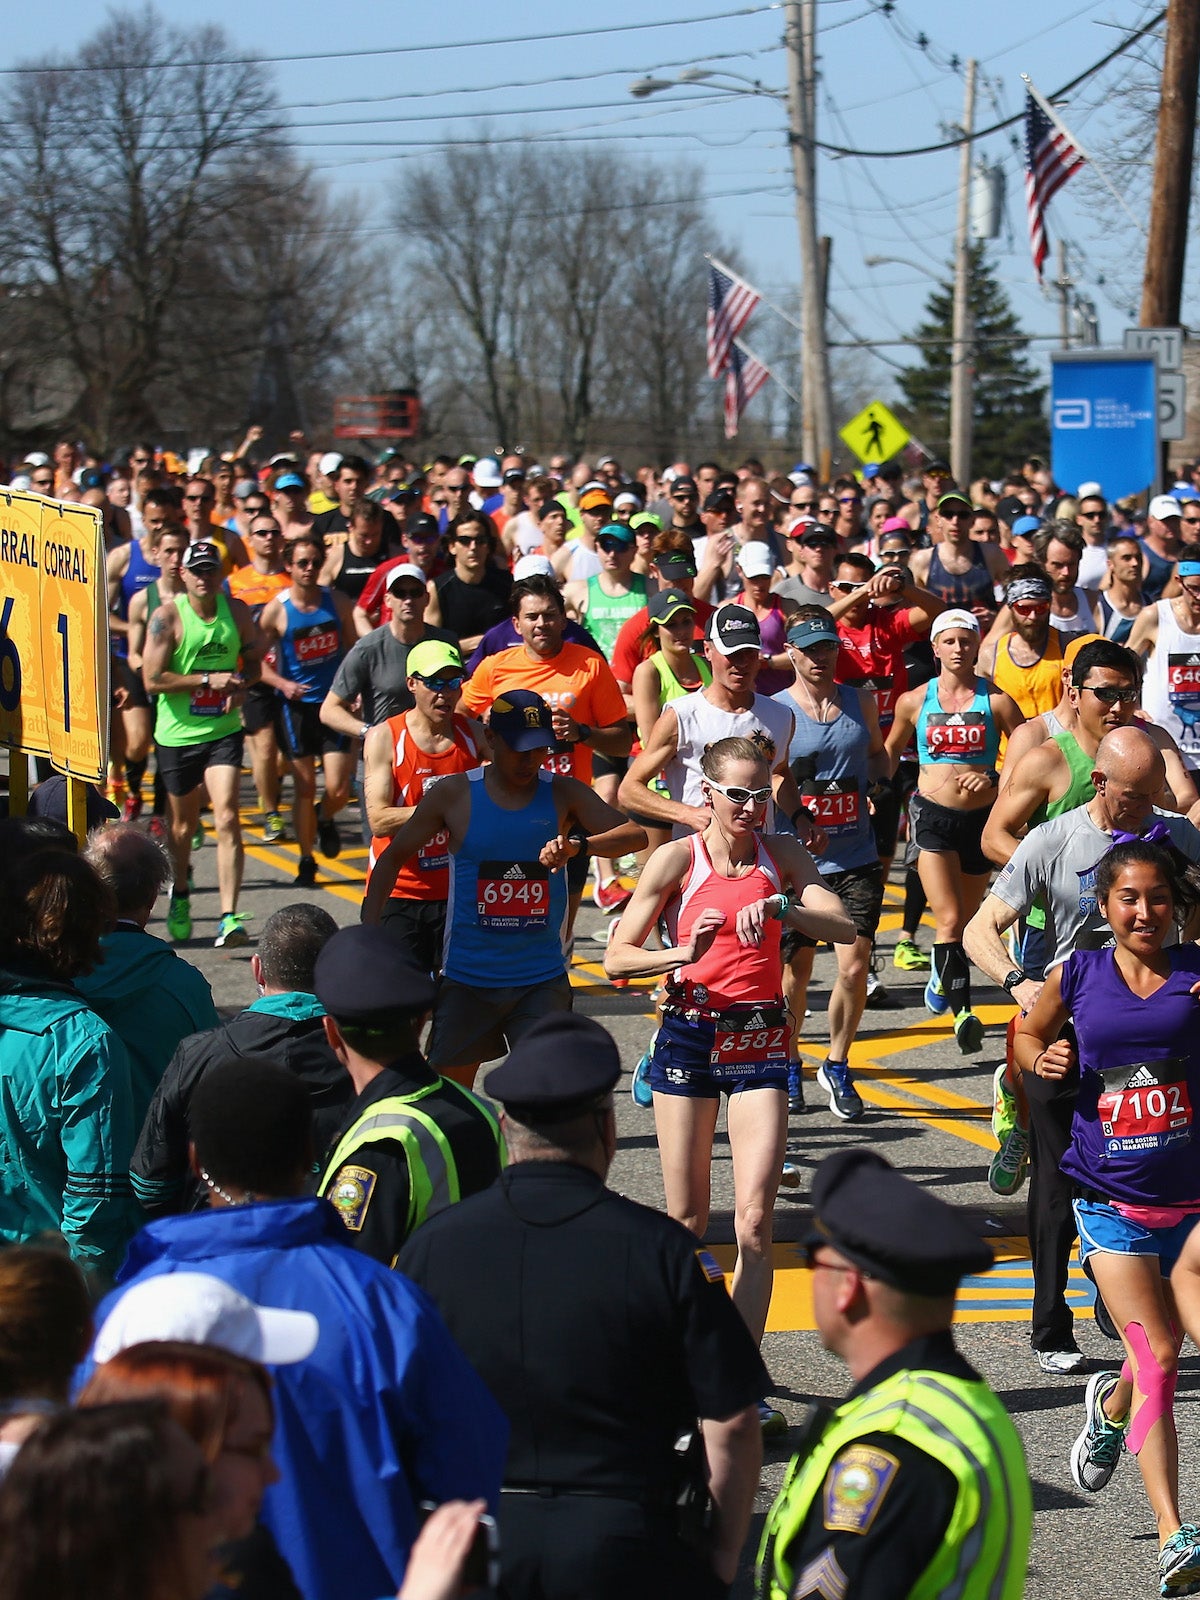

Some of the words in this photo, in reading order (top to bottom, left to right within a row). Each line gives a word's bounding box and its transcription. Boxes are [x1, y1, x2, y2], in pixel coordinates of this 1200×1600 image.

[1, 529, 38, 568] RRAL
[44, 540, 88, 583] CORRAL
[300, 633, 335, 654] 6422
[57, 613, 70, 733] 1
[874, 691, 891, 707] 17
[932, 727, 980, 744] 6130
[547, 754, 572, 775] 18
[808, 795, 855, 816] 6213
[484, 882, 544, 904] 6949
[479, 904, 485, 914] 7
[1079, 896, 1097, 917] ST
[744, 1022, 767, 1031] adidas
[720, 1029, 784, 1052] 6582
[712, 1052, 719, 1063] 7
[1128, 1077, 1159, 1088] adidas
[1106, 1086, 1186, 1122] 7102
[1104, 1122, 1112, 1135] 8
[1122, 1142, 1159, 1151] MARATHON
[1134, 1136, 1158, 1144] BOSTON
